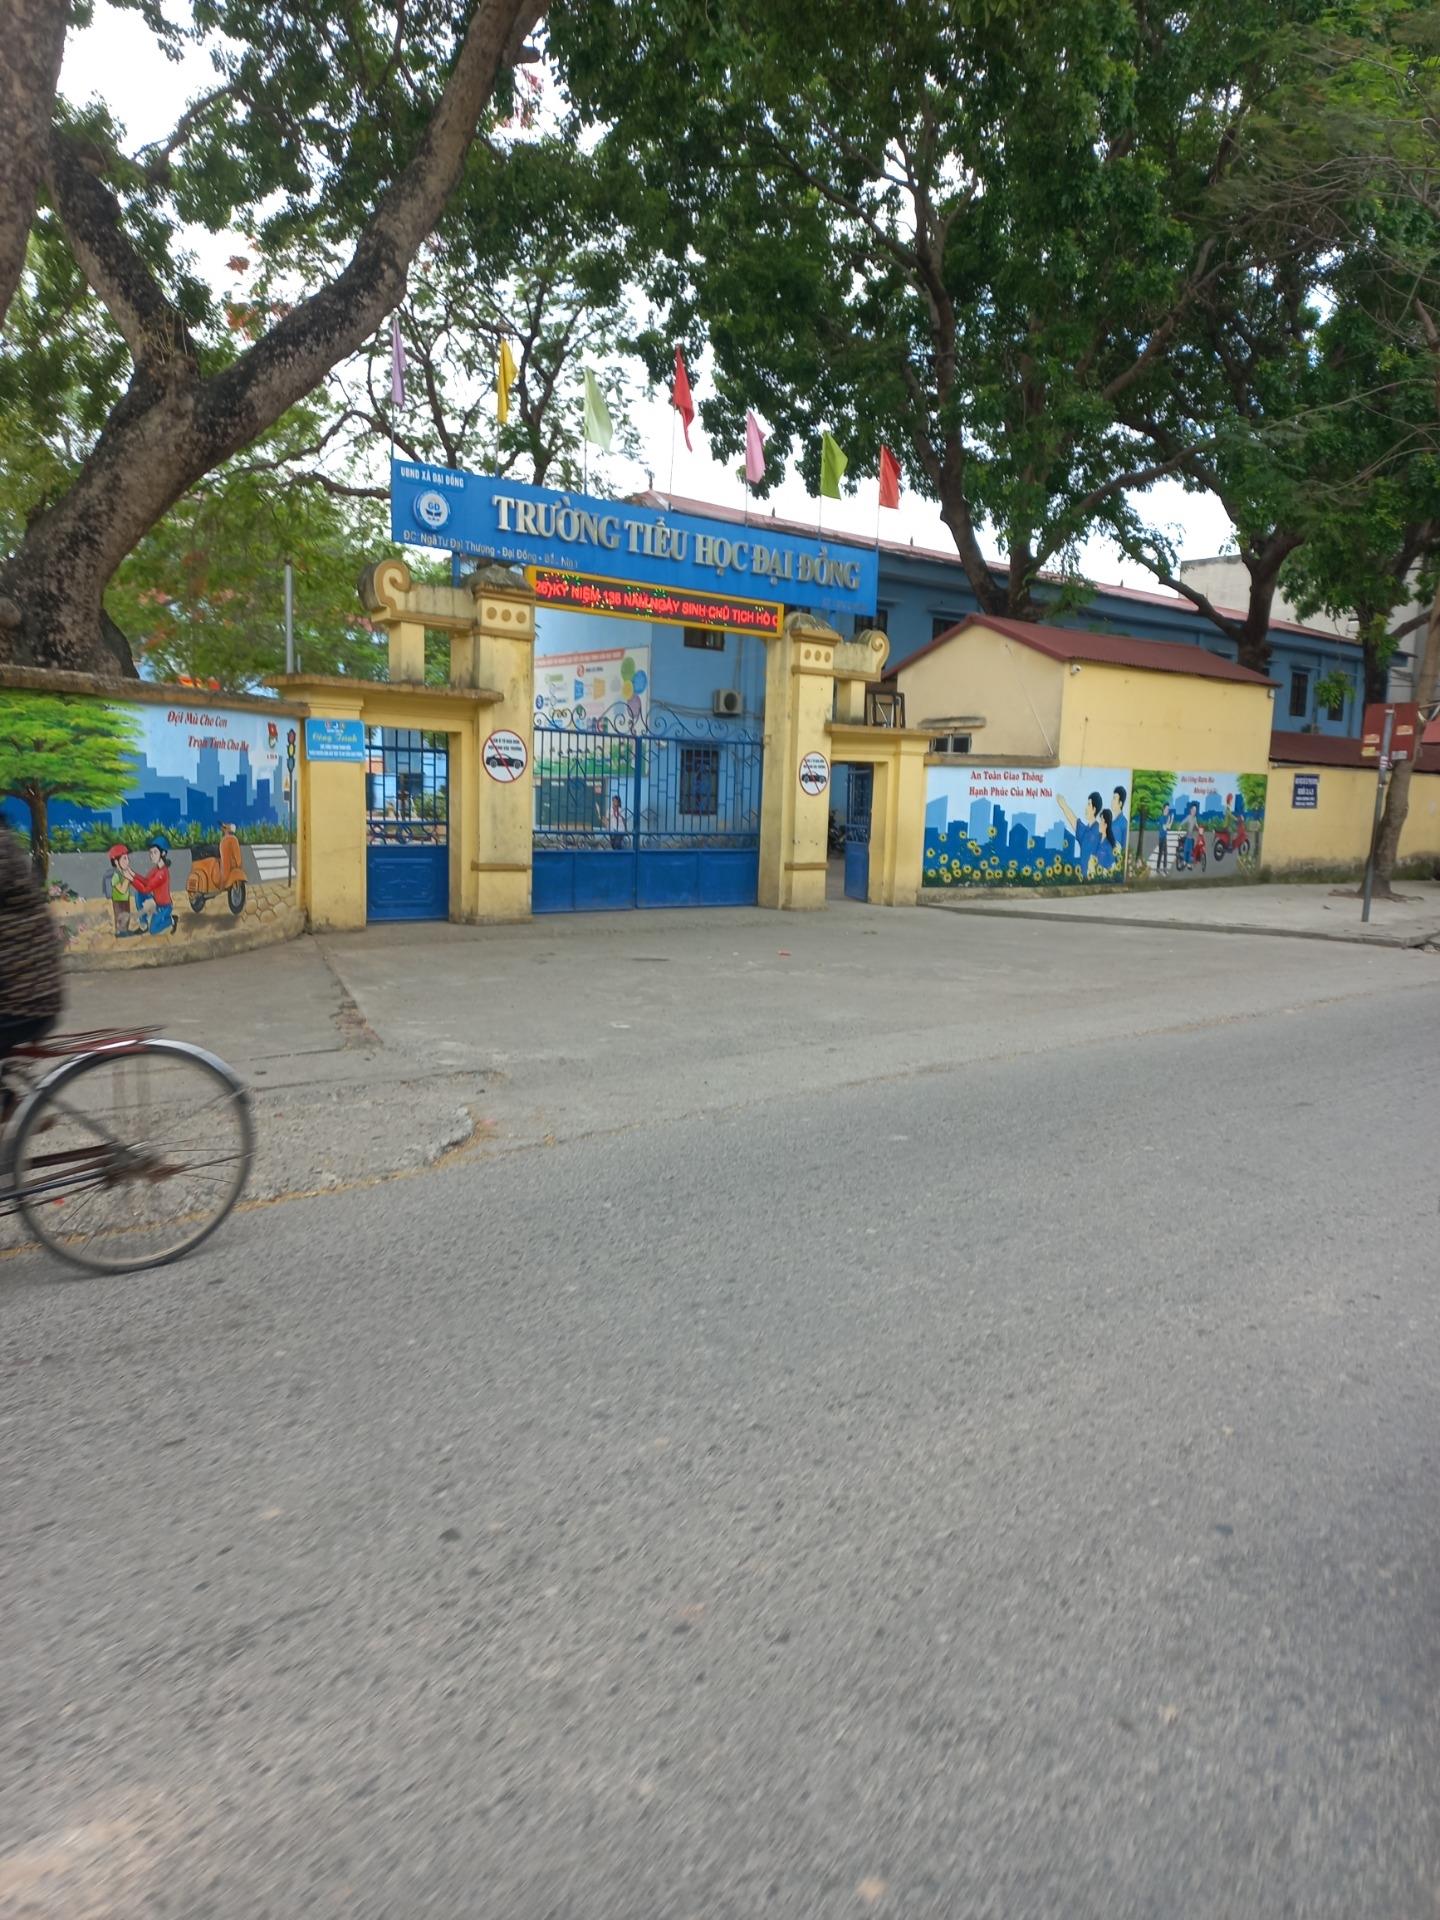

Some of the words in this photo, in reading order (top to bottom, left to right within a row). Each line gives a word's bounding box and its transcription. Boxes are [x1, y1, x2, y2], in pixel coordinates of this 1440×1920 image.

[400, 466, 420, 480] UBND
[432, 472, 444, 486] ĐẠI
[492, 494, 622, 549] TRƯỜNG
[624, 516, 690, 561] TIỂU
[693, 532, 749, 577] HỌC
[751, 543, 794, 586] ĐẠI
[797, 545, 862, 591] ĐỒNG
[682, 601, 706, 617] SINH
[732, 608, 754, 624] TỊCH
[200, 713, 213, 726] Cho
[215, 715, 228, 728] Con
[971, 770, 982, 780] An
[984, 770, 1001, 780] Toàn
[1003, 771, 1020, 780] Giao
[969, 786, 988, 798] Hạnh
[1026, 787, 1039, 799] Mọi
